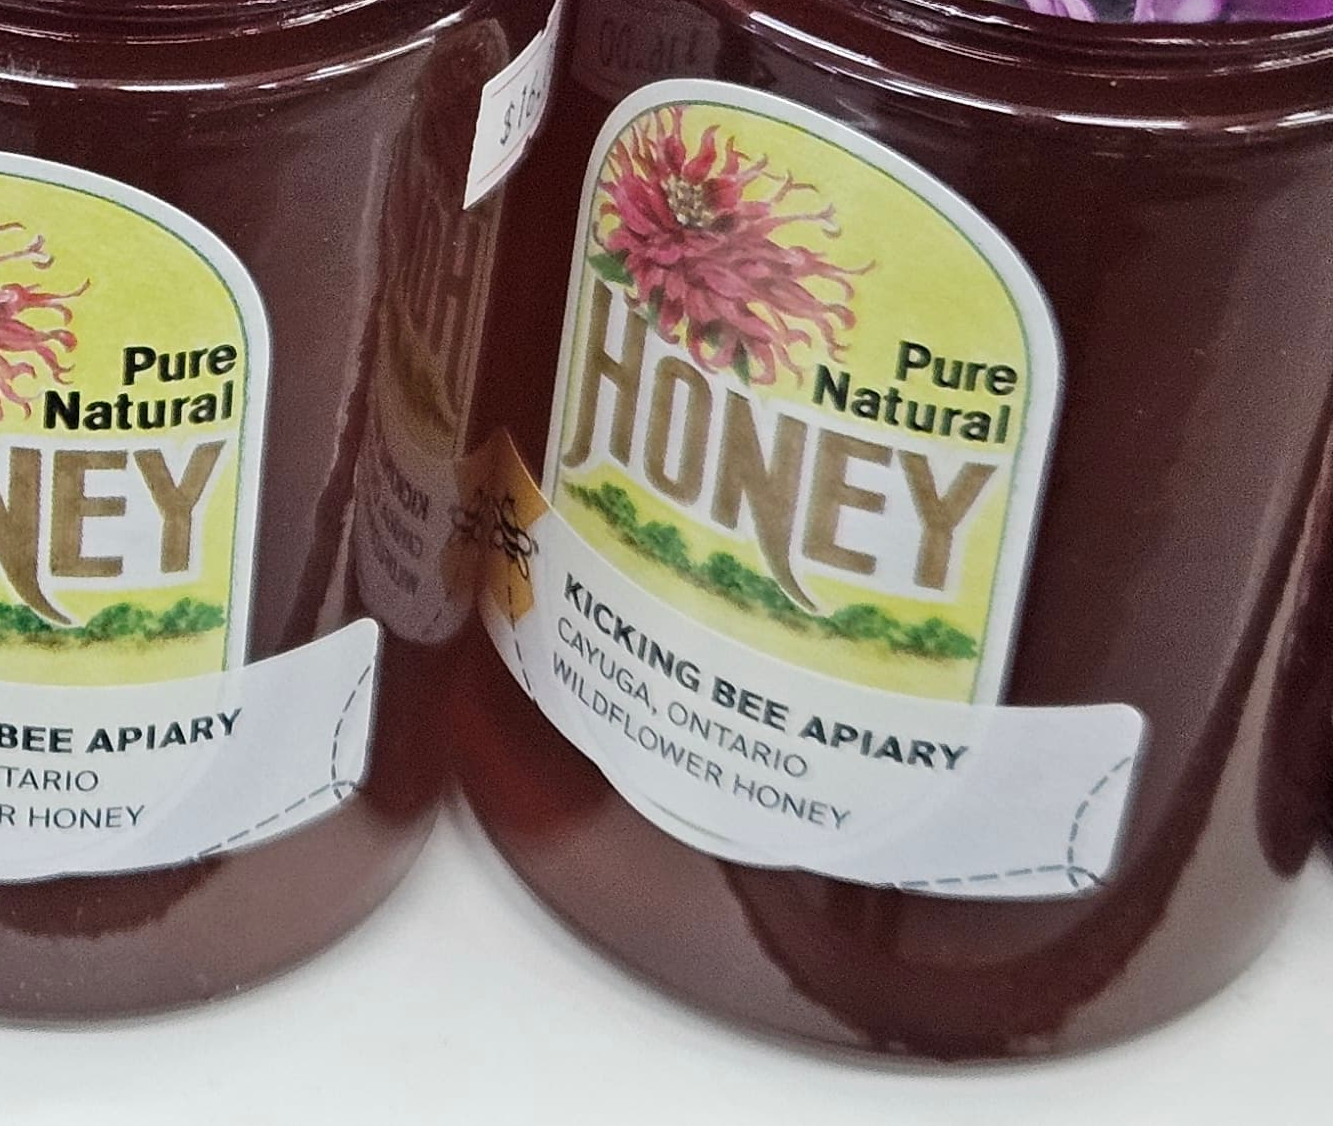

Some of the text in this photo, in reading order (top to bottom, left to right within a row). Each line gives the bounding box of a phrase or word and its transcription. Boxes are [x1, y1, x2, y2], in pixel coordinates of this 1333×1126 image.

[123, 344, 237, 385] Pure
[896, 340, 1017, 396] Pure
[43, 381, 233, 431] Natural
[813, 364, 1011, 444] Natural
[562, 280, 997, 614] HONEY
[557, 617, 808, 777] CAYUGA, ONTARIO
[565, 573, 969, 771] KICKING BEE APIARY
[85, 708, 242, 754] APIARY
[552, 651, 851, 830] WILDFLOWER HONEY
[28, 804, 144, 829] HONEY
